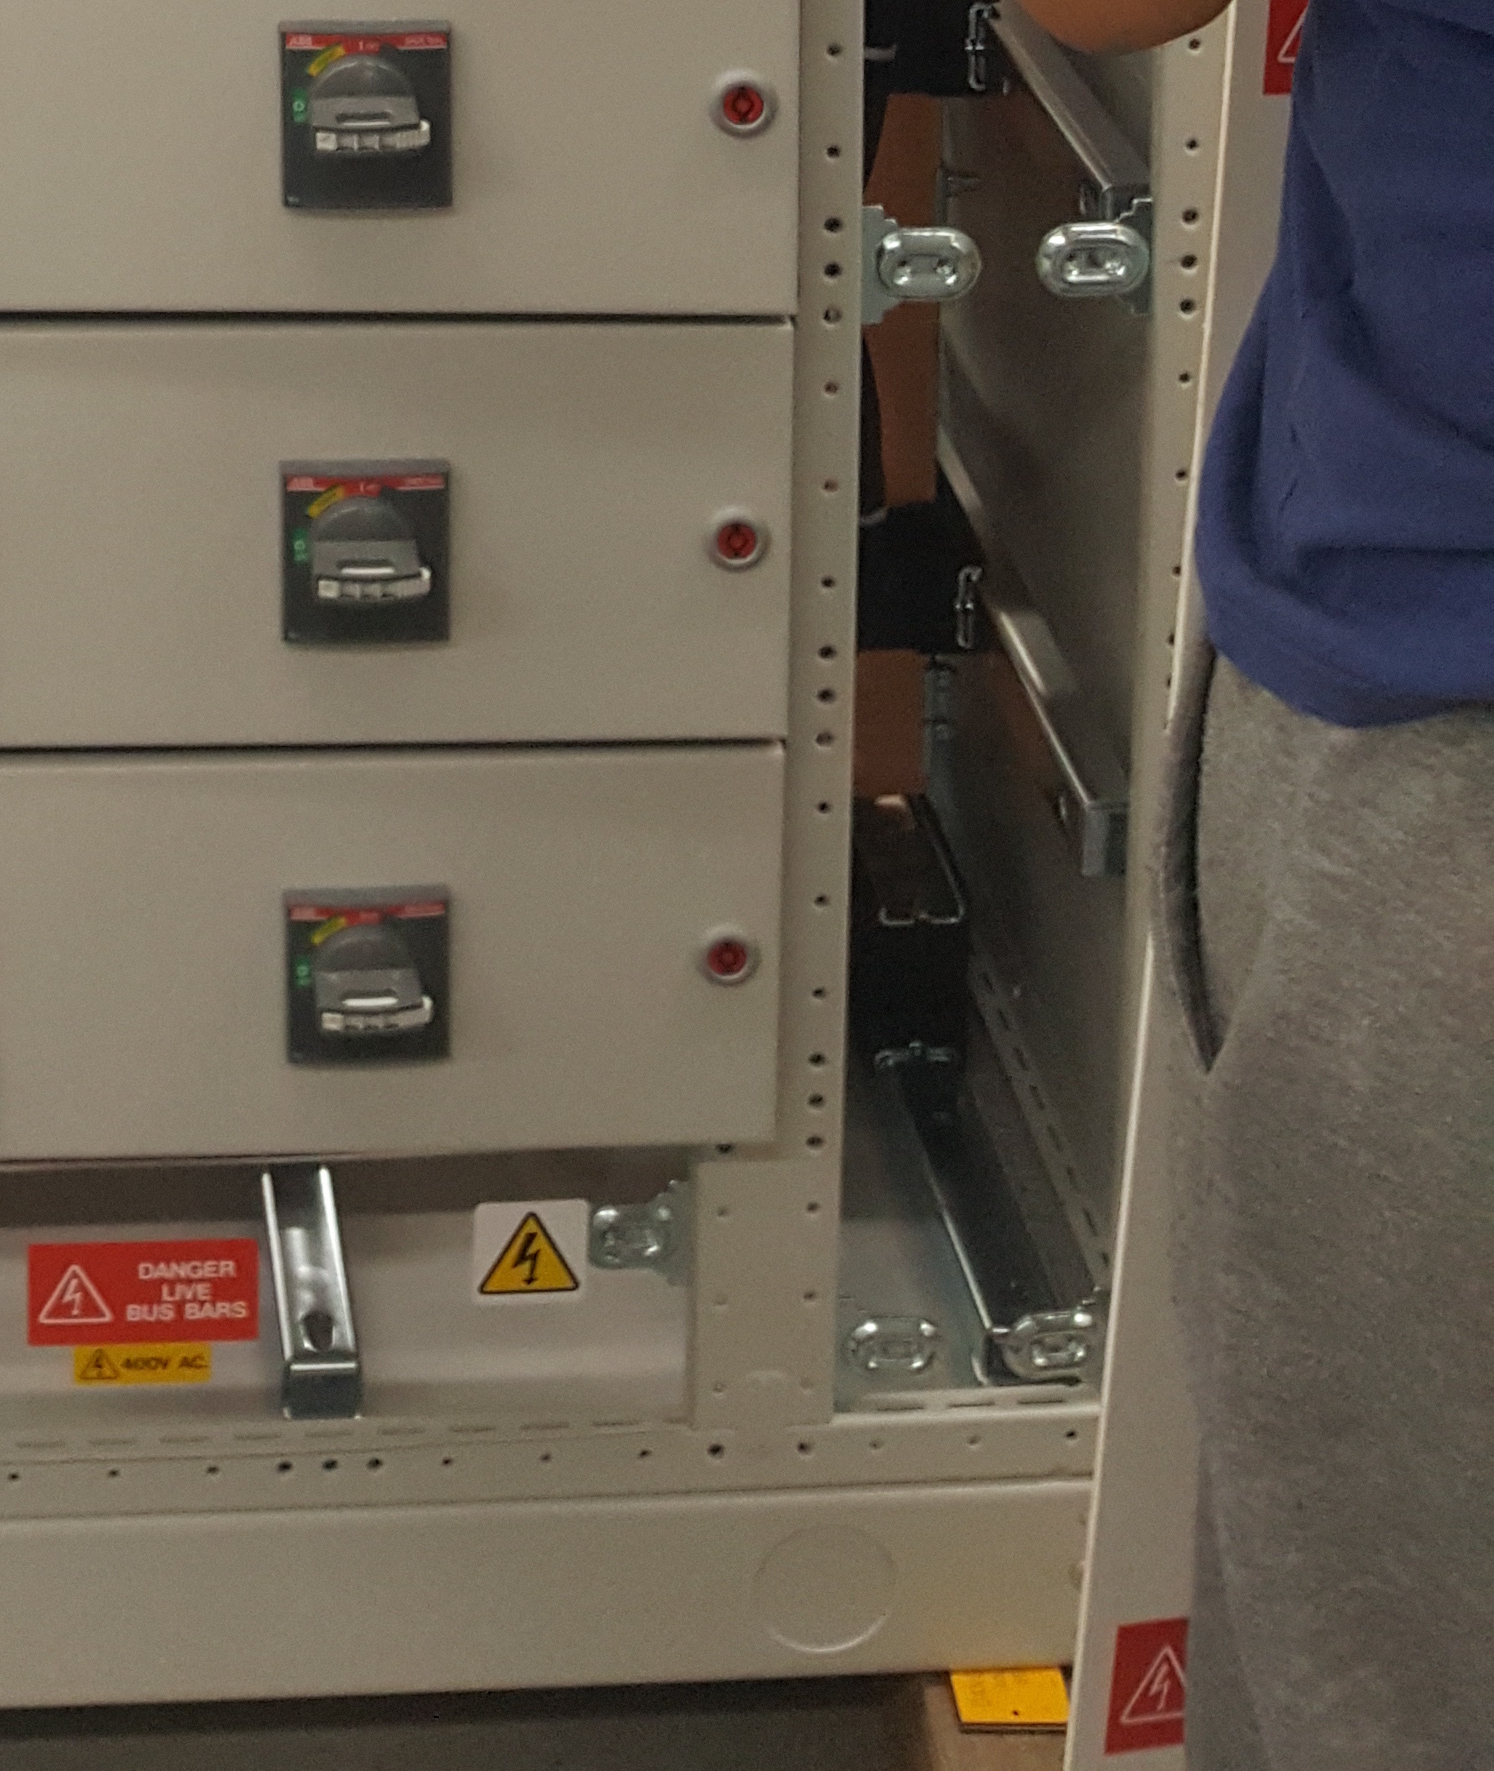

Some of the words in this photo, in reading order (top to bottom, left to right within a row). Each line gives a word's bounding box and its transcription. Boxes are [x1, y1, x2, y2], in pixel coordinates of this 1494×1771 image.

[139, 1261, 236, 1280] DANGER
[161, 1283, 211, 1302] LIVE
[127, 1304, 174, 1321] BUS
[184, 1302, 248, 1320] BARS
